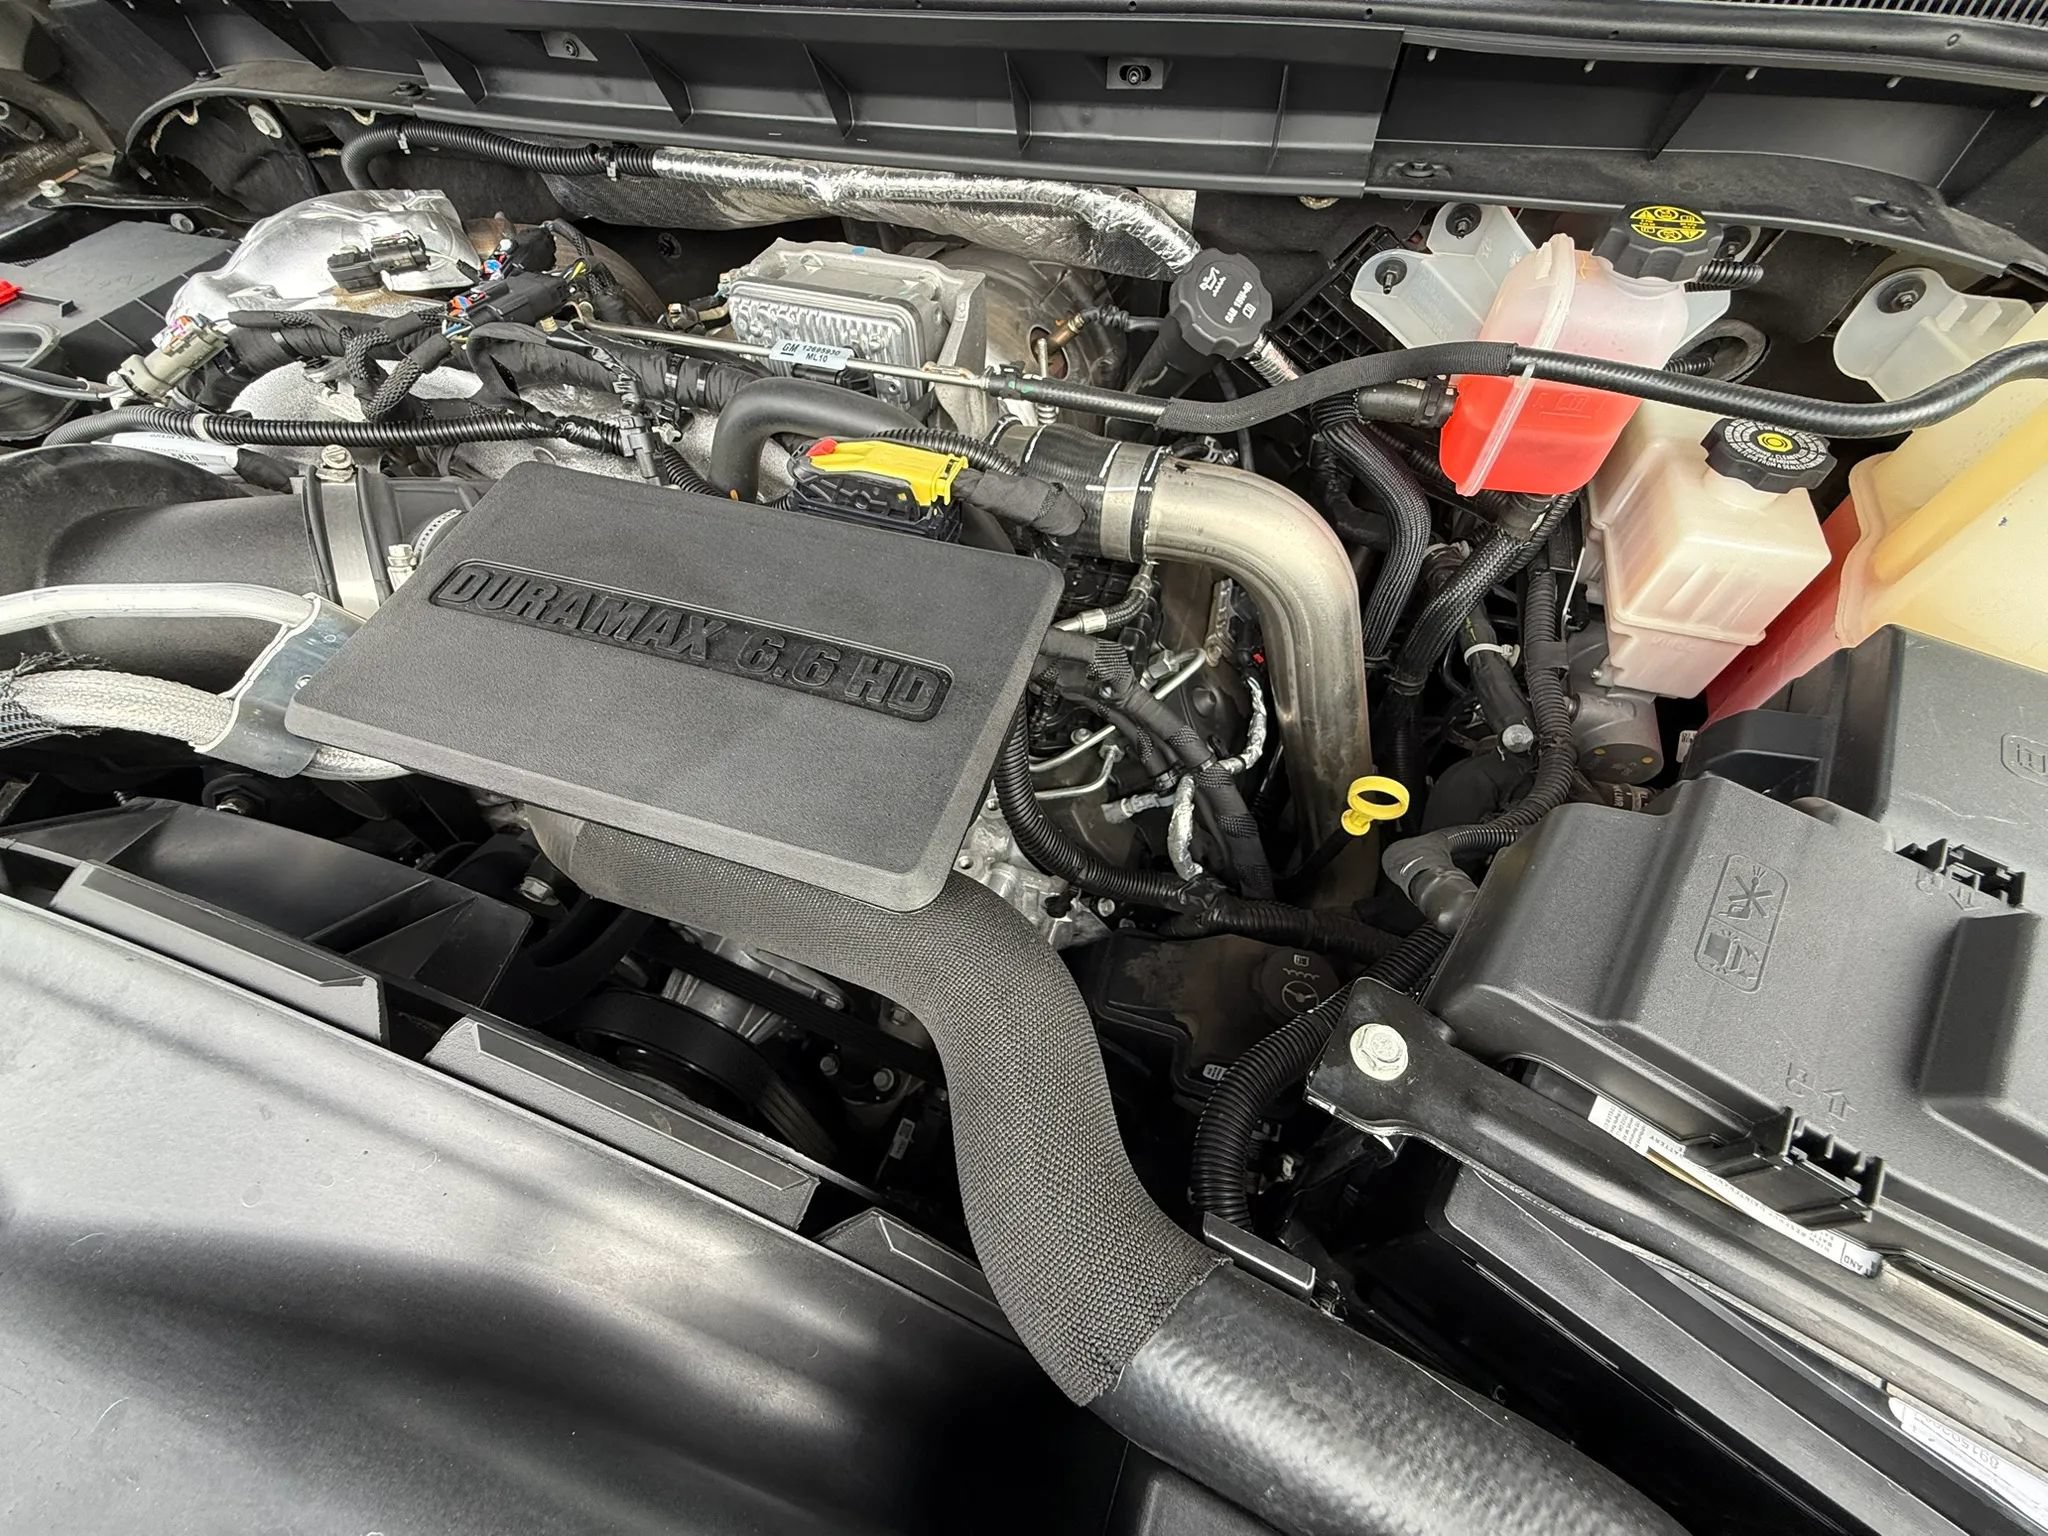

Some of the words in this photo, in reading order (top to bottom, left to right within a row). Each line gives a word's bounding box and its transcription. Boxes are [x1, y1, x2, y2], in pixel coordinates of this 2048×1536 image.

[782, 342, 800, 353] GM
[805, 352, 828, 363] ML10
[438, 565, 728, 660] DURAMAX
[736, 630, 842, 687] 6.6
[844, 655, 941, 713] HD
[1843, 1255, 1863, 1271] AND
